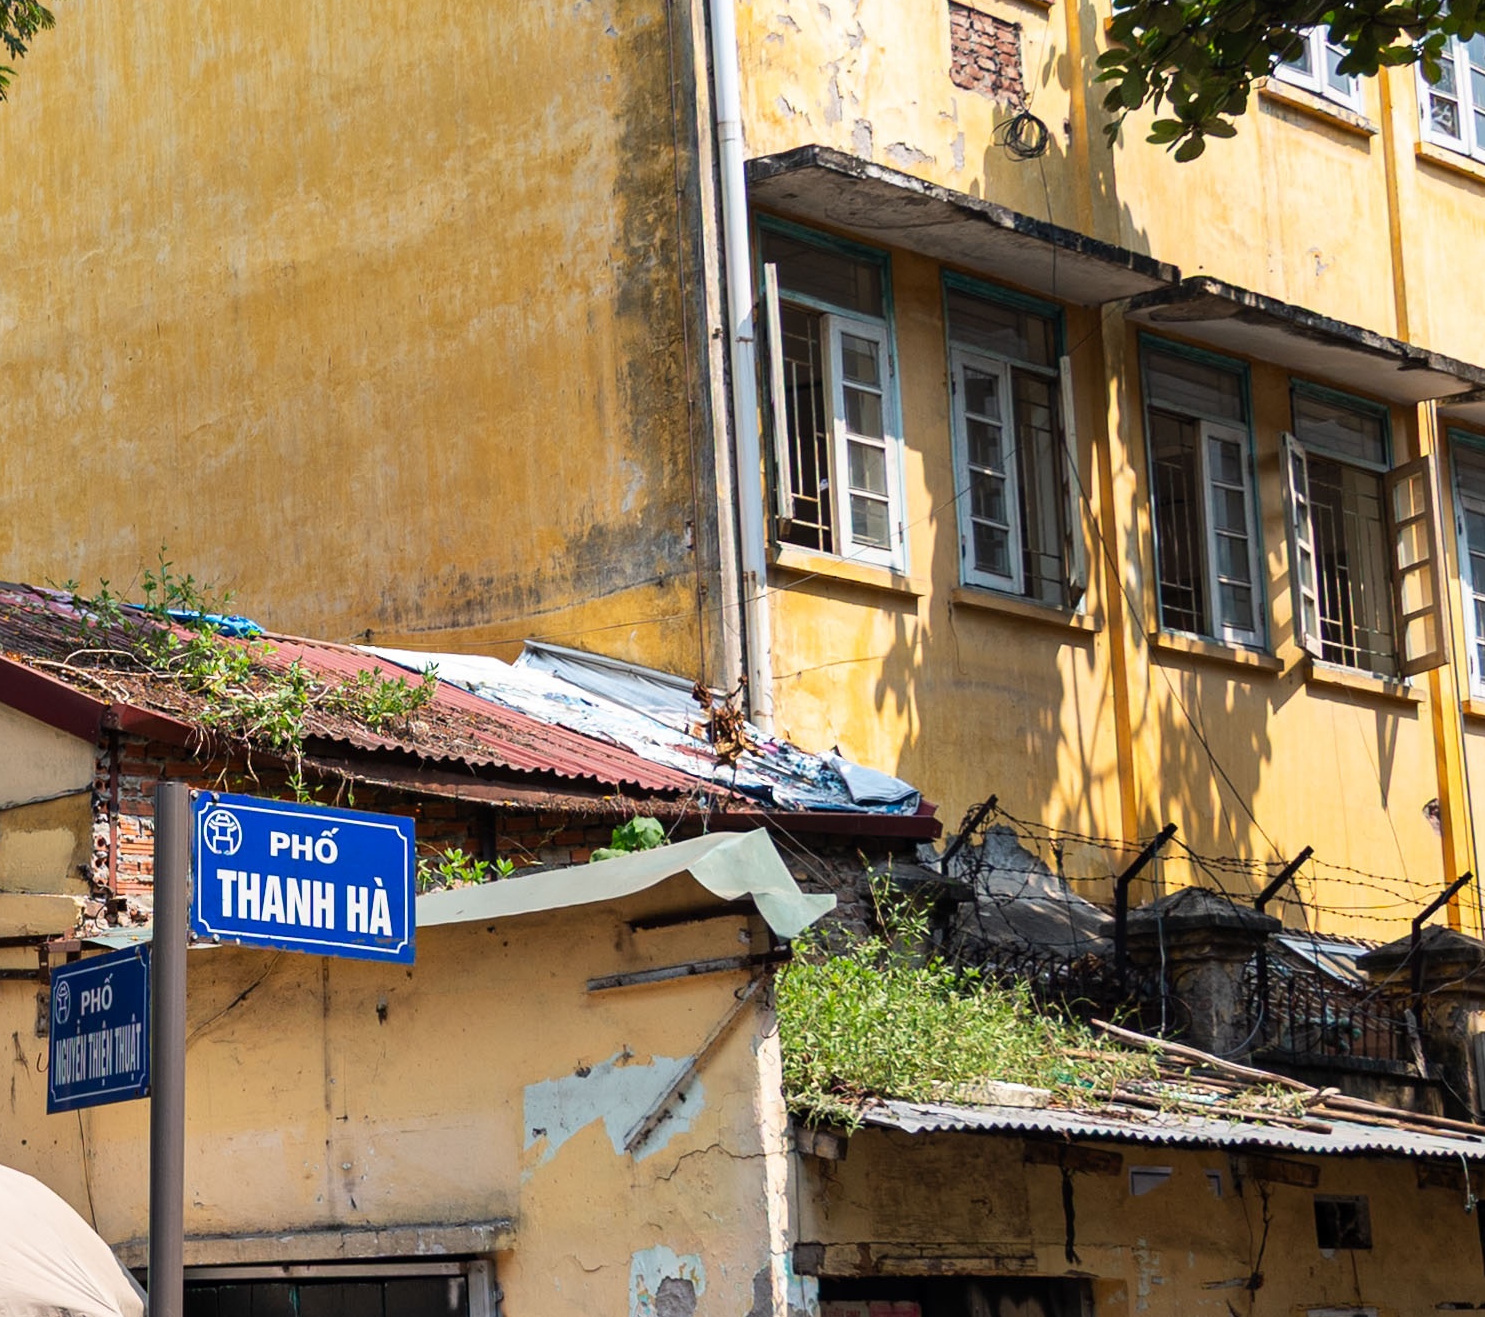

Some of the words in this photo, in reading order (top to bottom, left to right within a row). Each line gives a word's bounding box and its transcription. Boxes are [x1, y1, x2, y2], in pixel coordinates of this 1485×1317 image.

[269, 826, 339, 864] PHỐ
[217, 868, 335, 930] THANH
[346, 876, 394, 937] HÀ
[81, 973, 113, 1016] PHỐ
[88, 1020, 113, 1086] THIỆN
[114, 1013, 142, 1081] THUẬT
